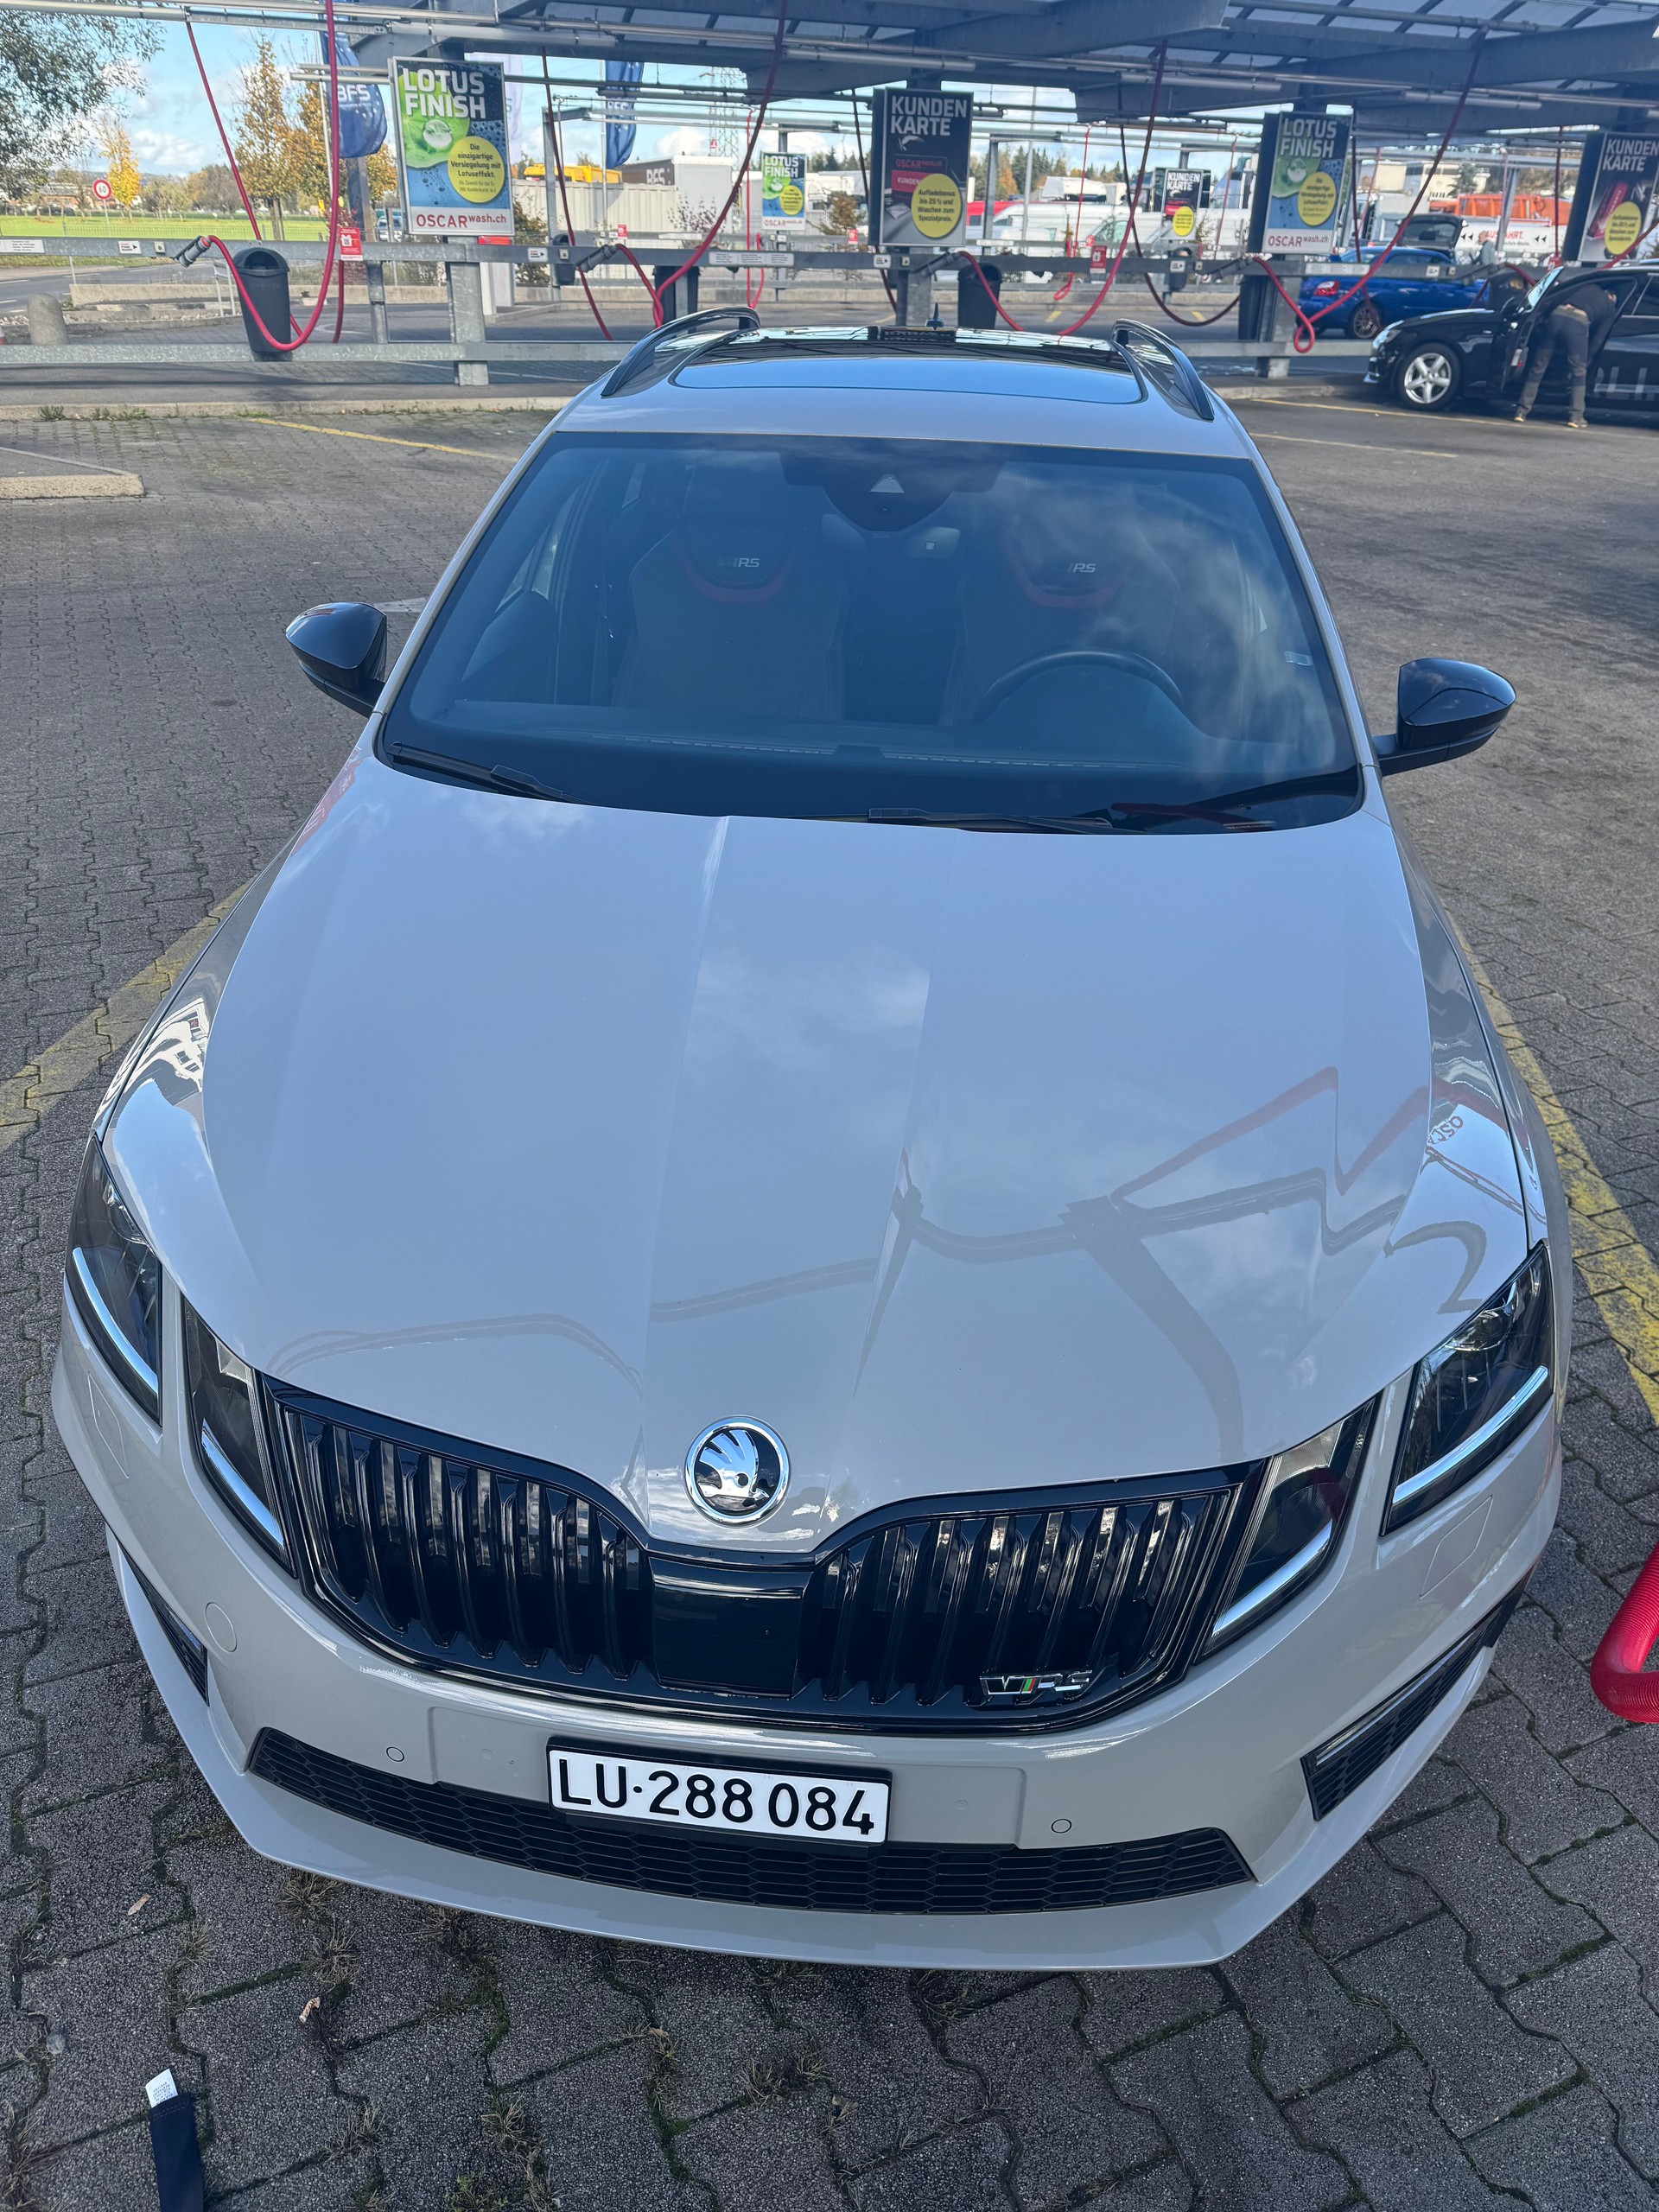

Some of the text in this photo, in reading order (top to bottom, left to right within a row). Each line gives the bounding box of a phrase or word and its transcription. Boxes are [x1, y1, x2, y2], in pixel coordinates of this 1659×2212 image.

[403, 68, 485, 94] LOTUS
[404, 93, 486, 118] FINISH
[892, 96, 967, 118] KUNDEN
[890, 116, 951, 136] KARTE
[1283, 118, 1338, 138] LOTUS
[1280, 138, 1335, 158] FINISH
[1605, 138, 1659, 156] KUNDEN
[457, 151, 493, 162] einzigartige
[764, 155, 799, 167] LOTUS
[1602, 155, 1647, 171] KARTE
[450, 161, 489, 170] Versiegelung
[764, 167, 798, 178] FINISH
[1167, 172, 1201, 183] KUNDEN
[99, 185, 106, 194] 60
[1166, 181, 1193, 191] KARTE
